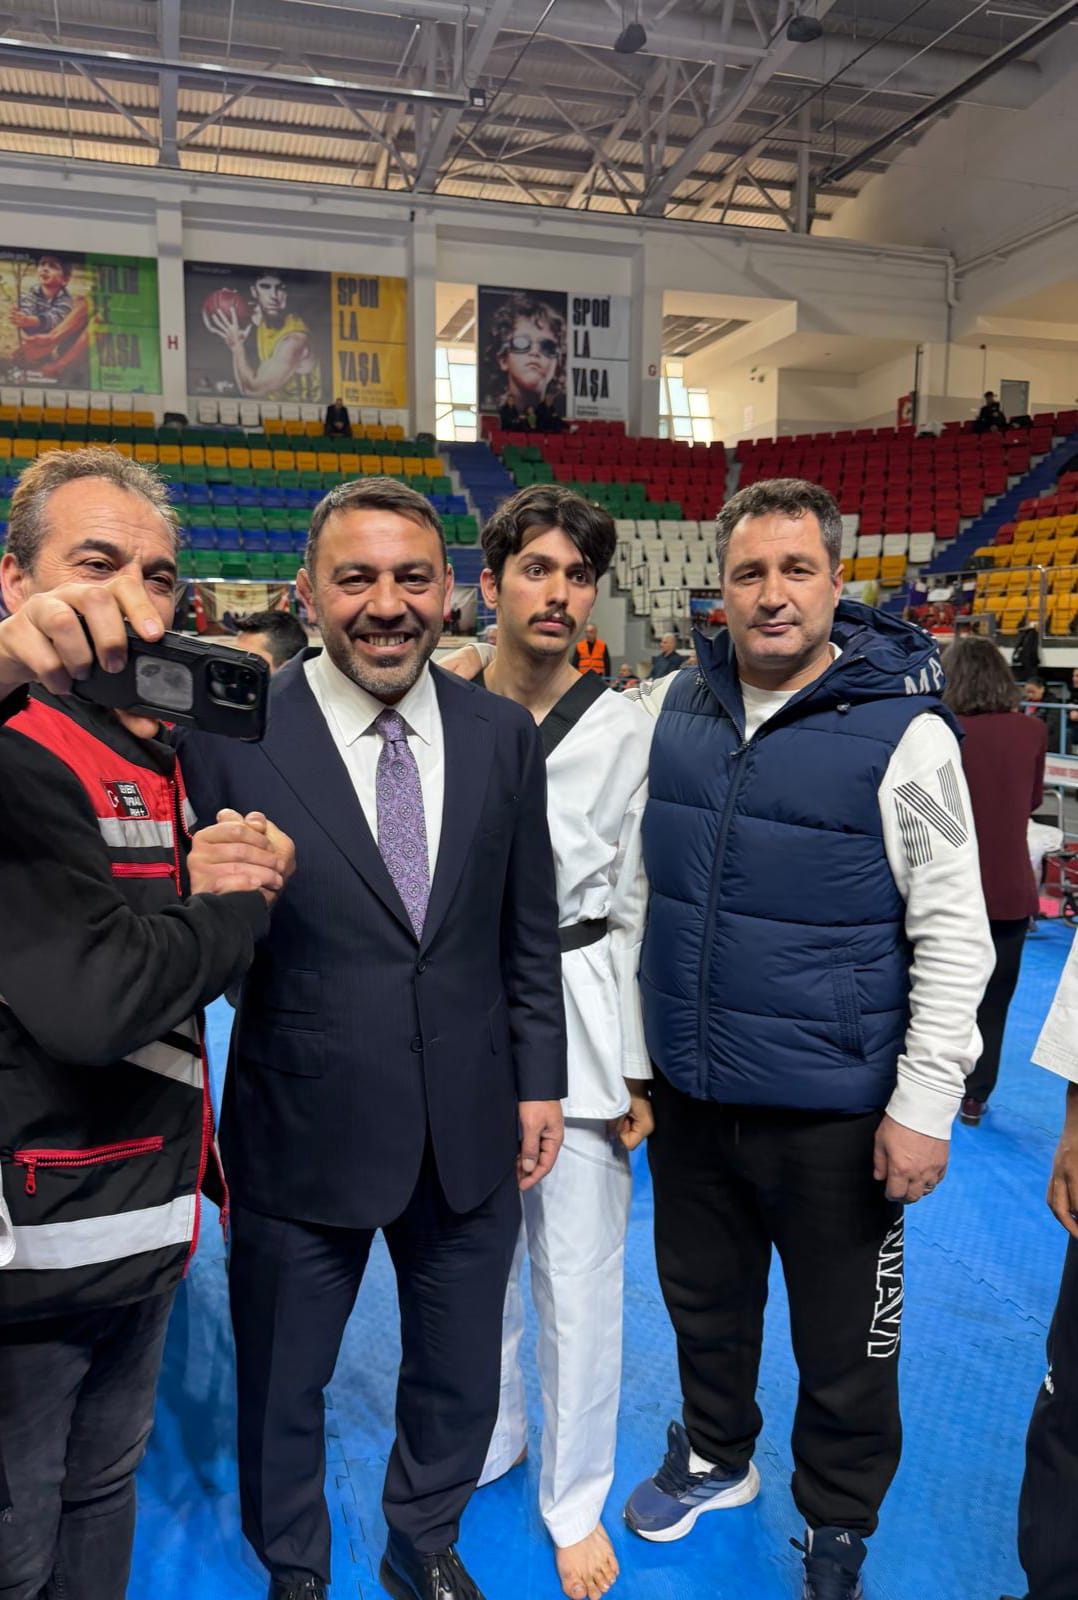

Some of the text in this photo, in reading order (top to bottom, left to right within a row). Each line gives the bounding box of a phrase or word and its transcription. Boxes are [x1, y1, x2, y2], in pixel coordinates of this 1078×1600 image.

[338, 277, 379, 308] SPOR
[339, 310, 358, 341] LA
[573, 298, 610, 328] SPOR
[168, 335, 178, 350] H
[574, 330, 590, 358] LA
[339, 351, 380, 386] YAŞA
[572, 368, 609, 402] YAŞA
